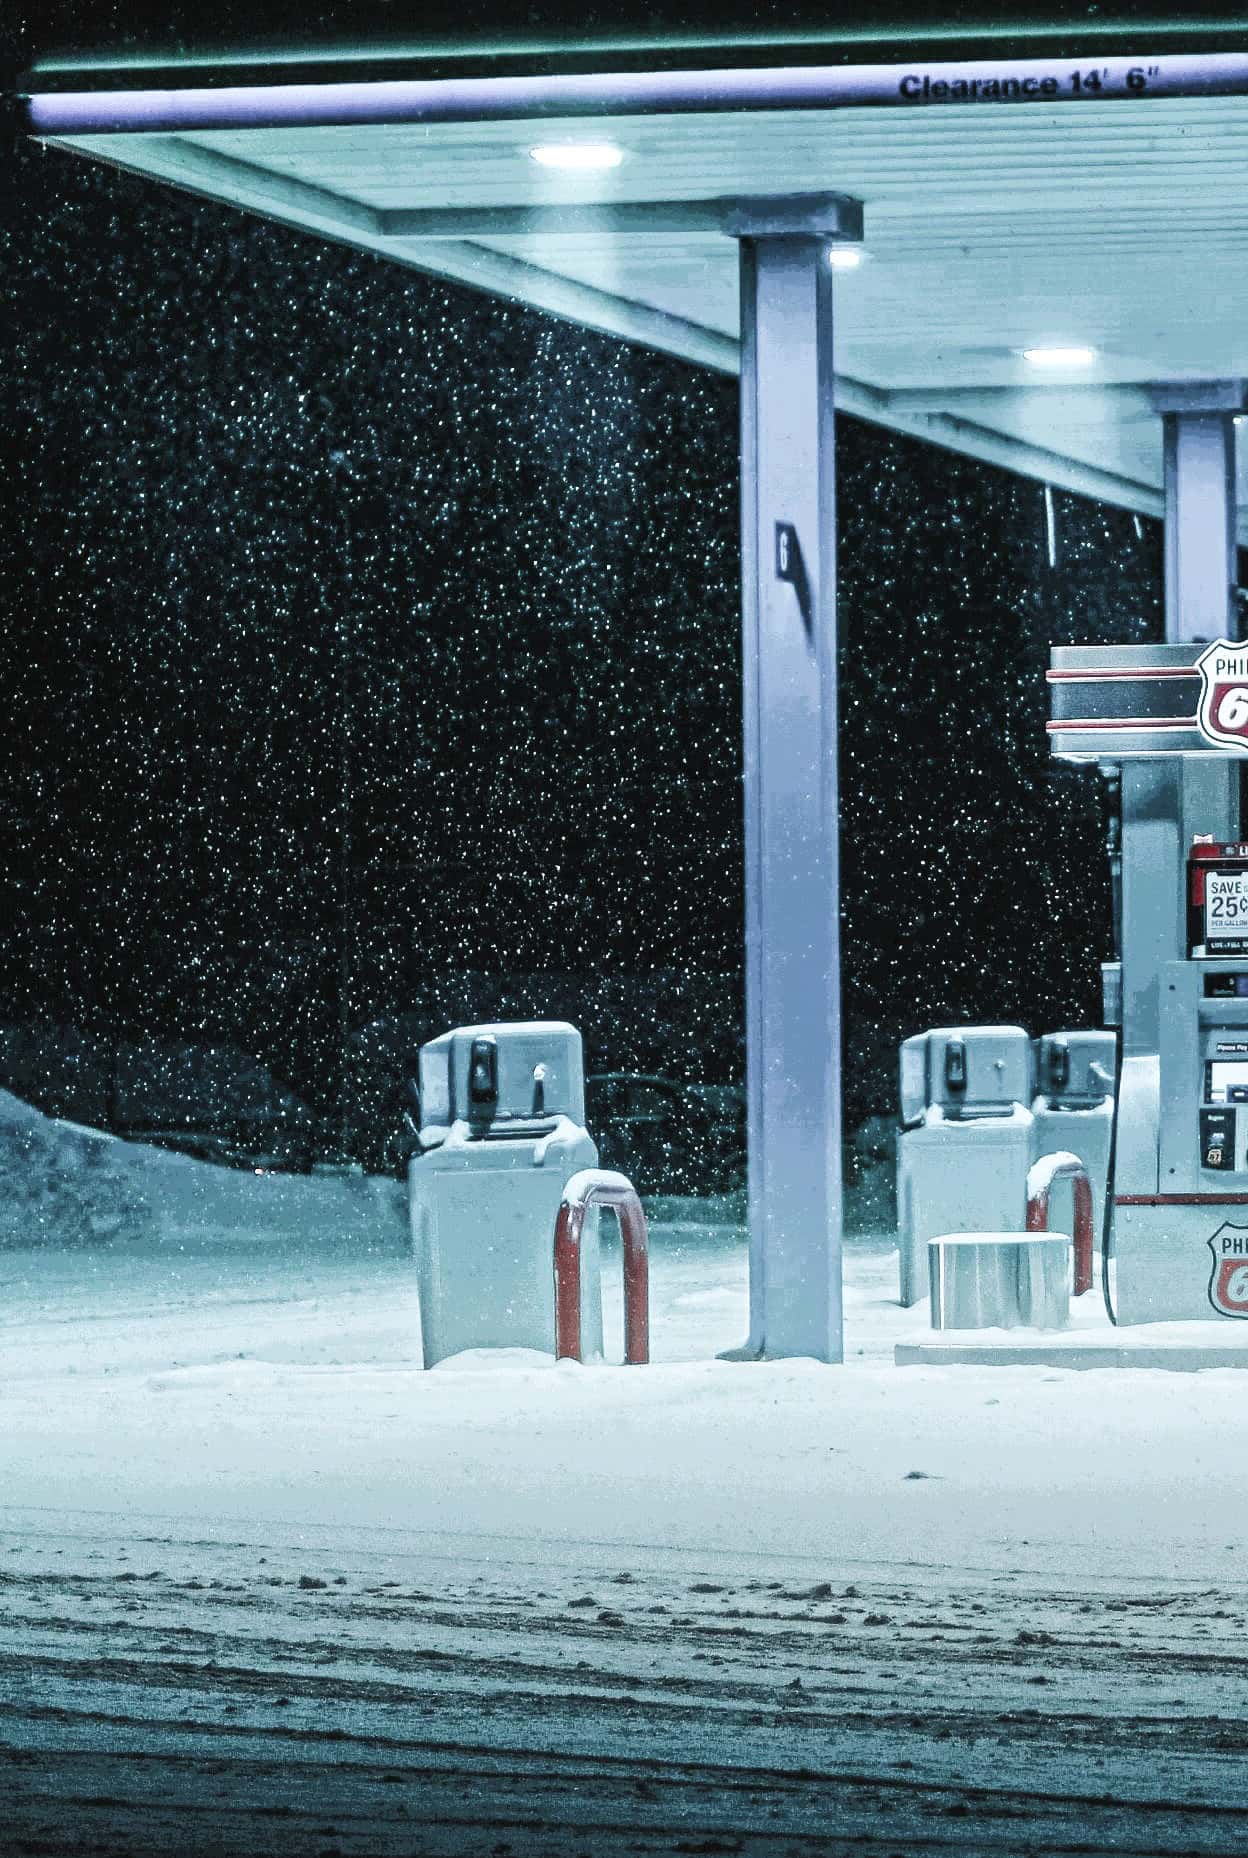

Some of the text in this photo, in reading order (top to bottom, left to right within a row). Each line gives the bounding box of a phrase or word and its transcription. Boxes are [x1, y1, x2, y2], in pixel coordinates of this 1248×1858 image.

[900, 75, 1058, 98] Clearance
[1211, 882, 1242, 894] SAVE
[1211, 897, 1248, 917] 25¢
